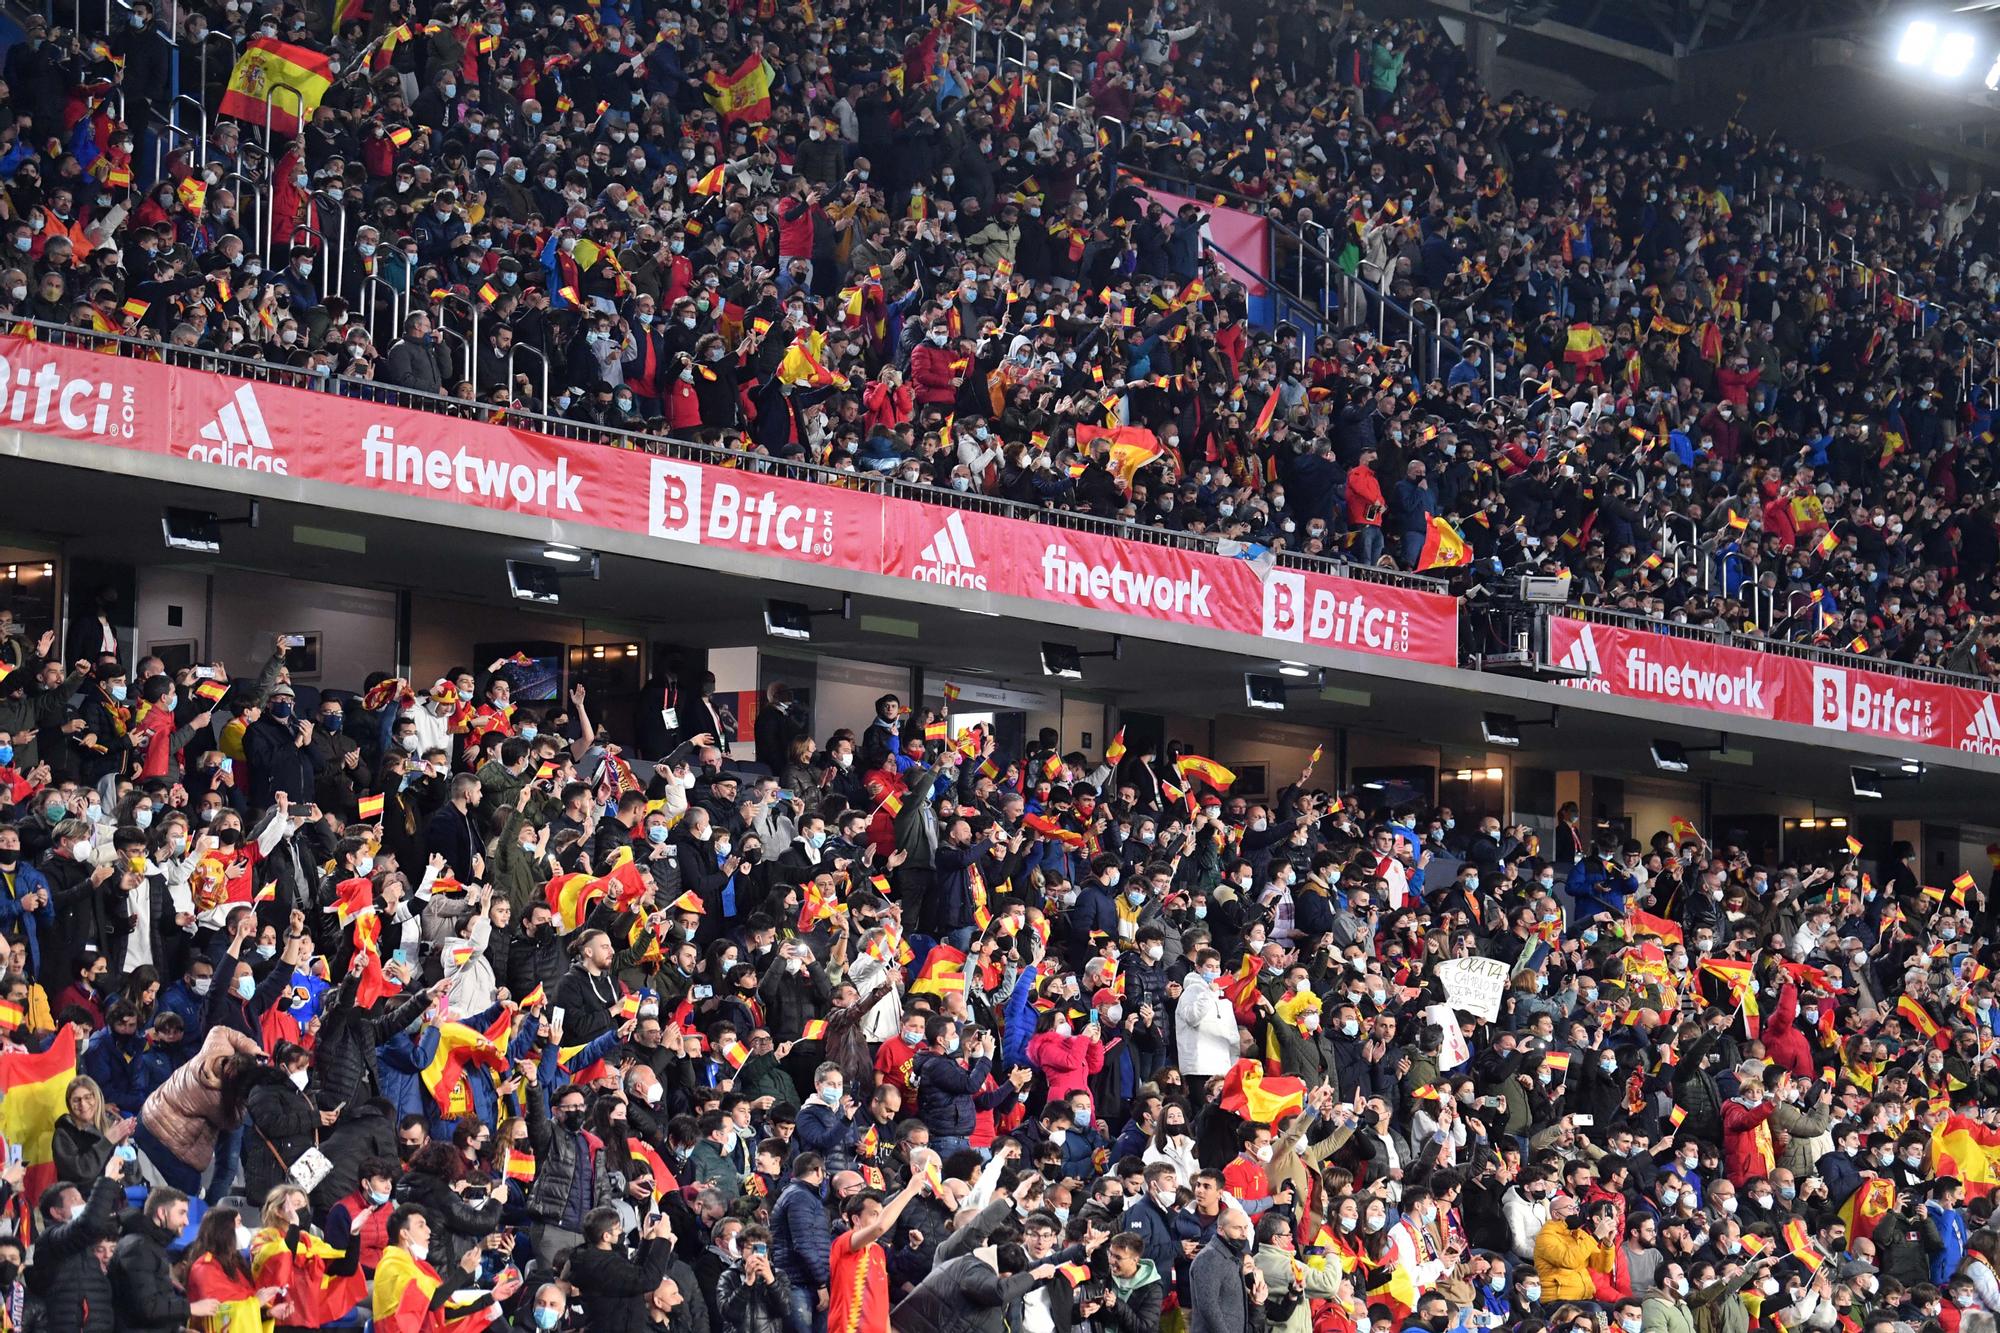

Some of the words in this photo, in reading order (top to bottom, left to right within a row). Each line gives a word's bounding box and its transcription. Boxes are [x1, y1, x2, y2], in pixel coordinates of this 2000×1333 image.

[361, 424, 583, 513] finetwork
[708, 482, 817, 553] Bitci
[1042, 544, 1212, 617] finetwork
[1309, 589, 1396, 650] Bitci
[1626, 647, 1765, 709] finetwork
[1851, 683, 1921, 736] Bitci
